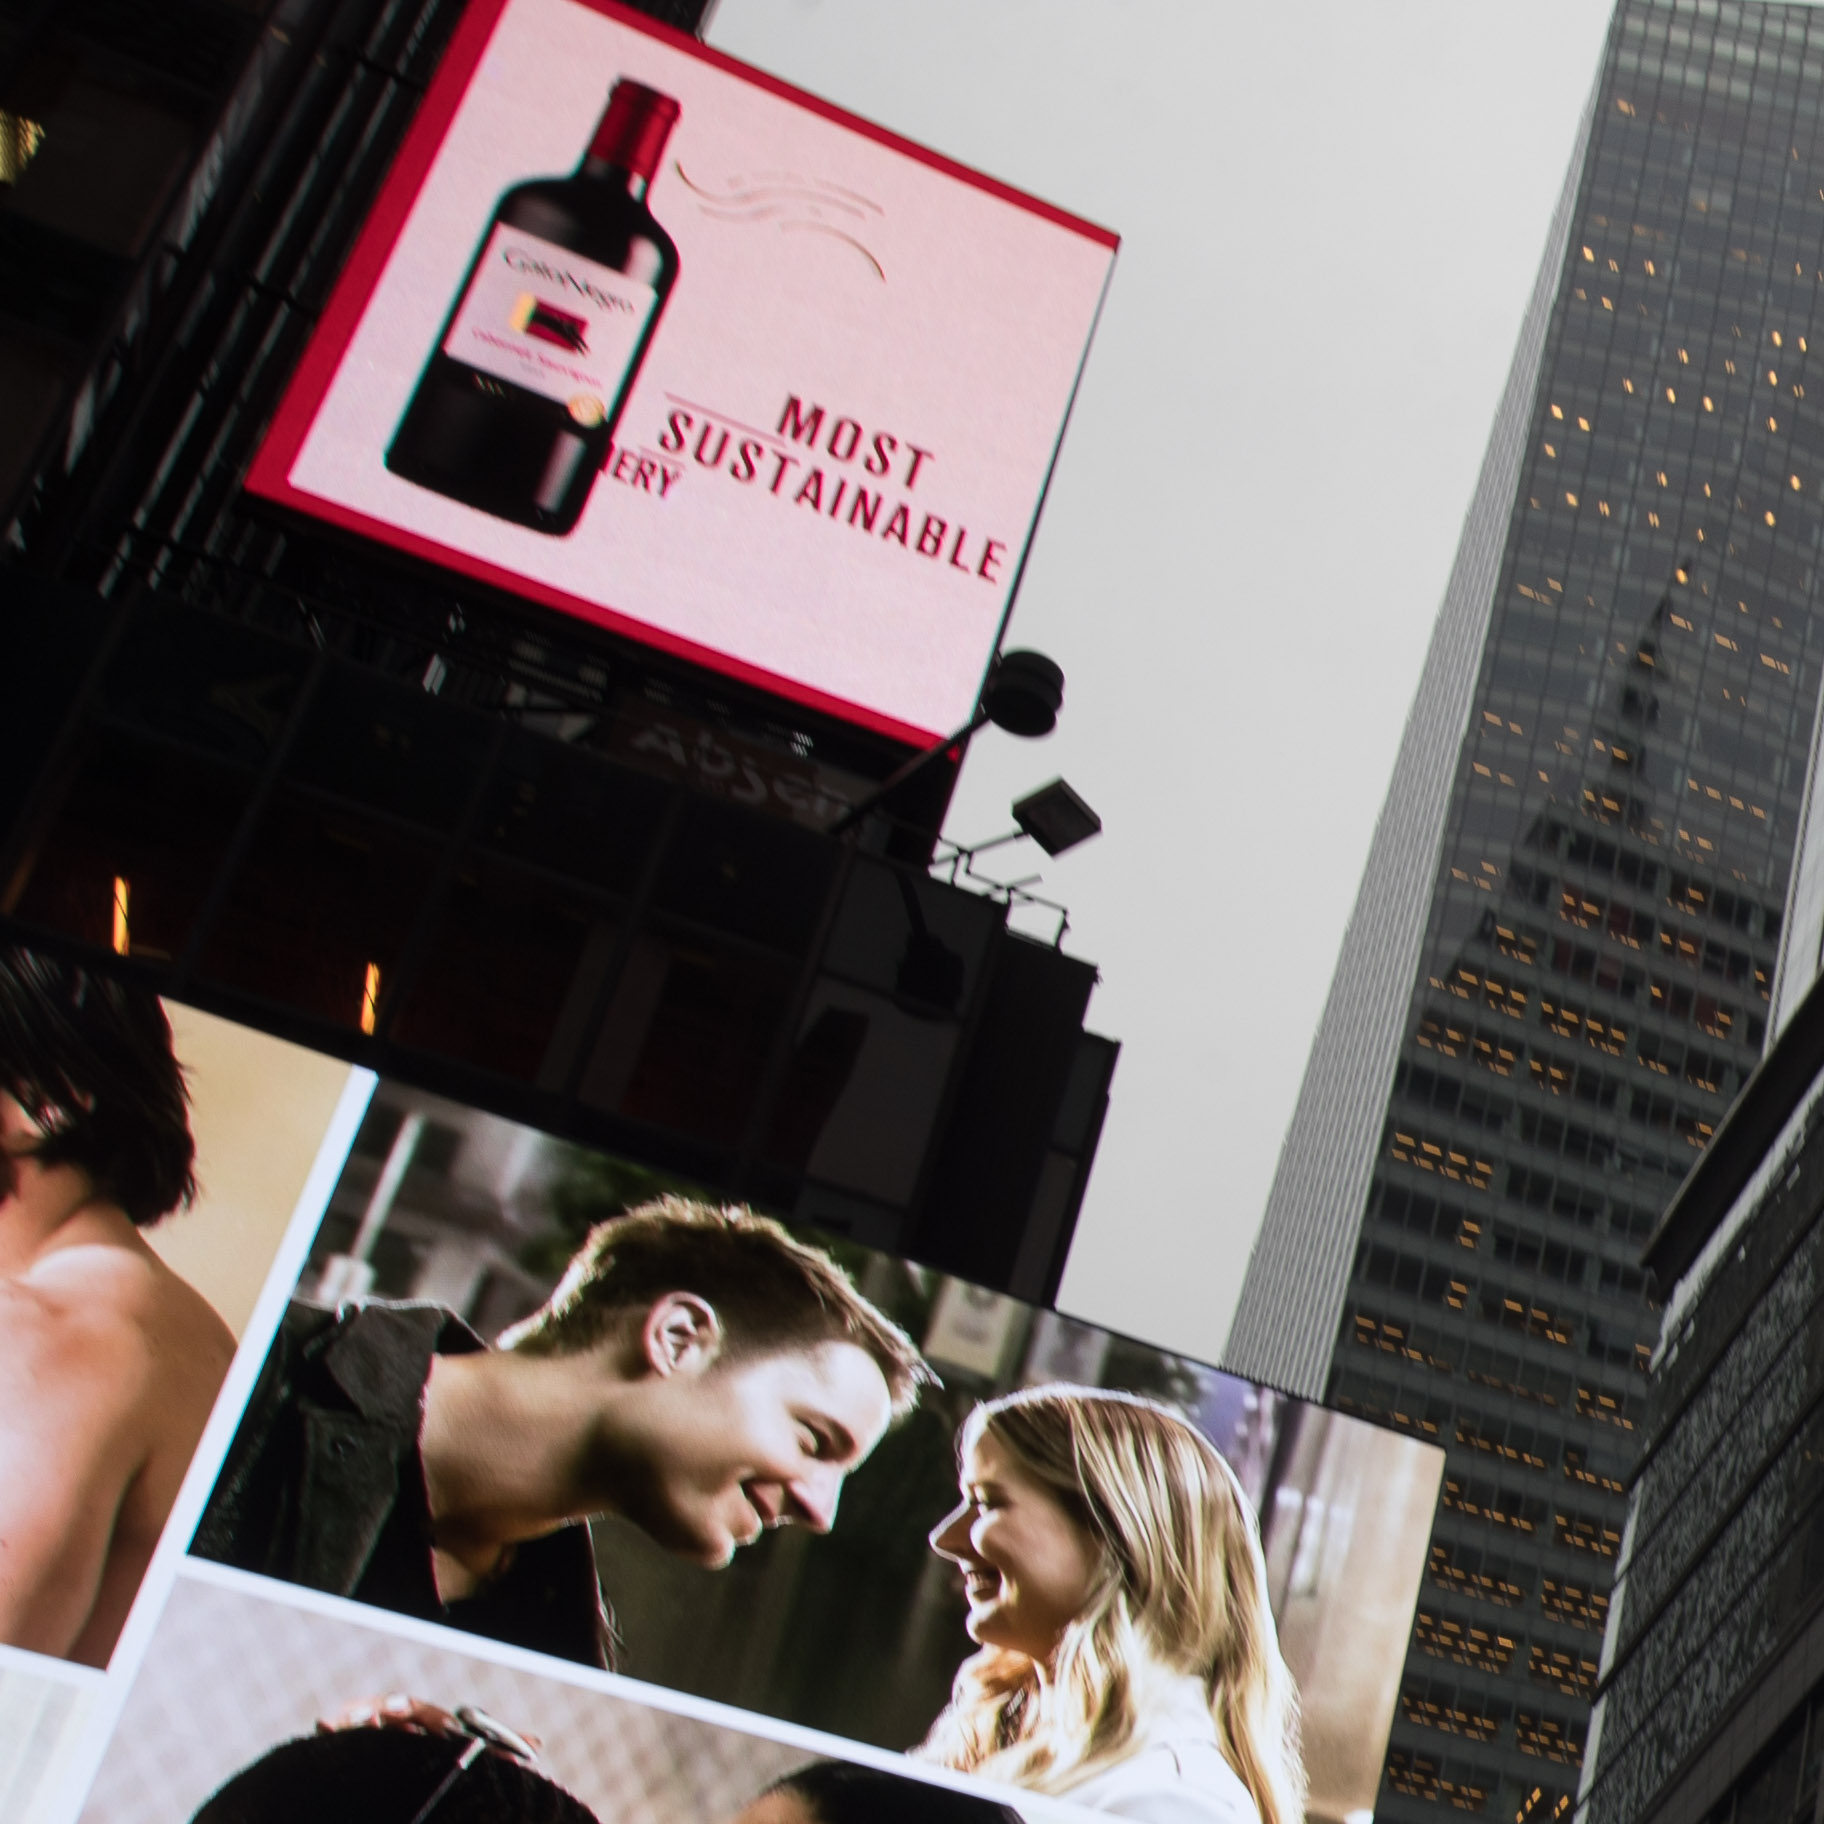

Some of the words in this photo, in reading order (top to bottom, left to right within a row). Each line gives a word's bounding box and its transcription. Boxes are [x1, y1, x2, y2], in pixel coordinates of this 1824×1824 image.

[602, 440, 684, 500] ERY
[776, 394, 935, 490] MOST
[658, 410, 1008, 584] SUSTAINABLE
